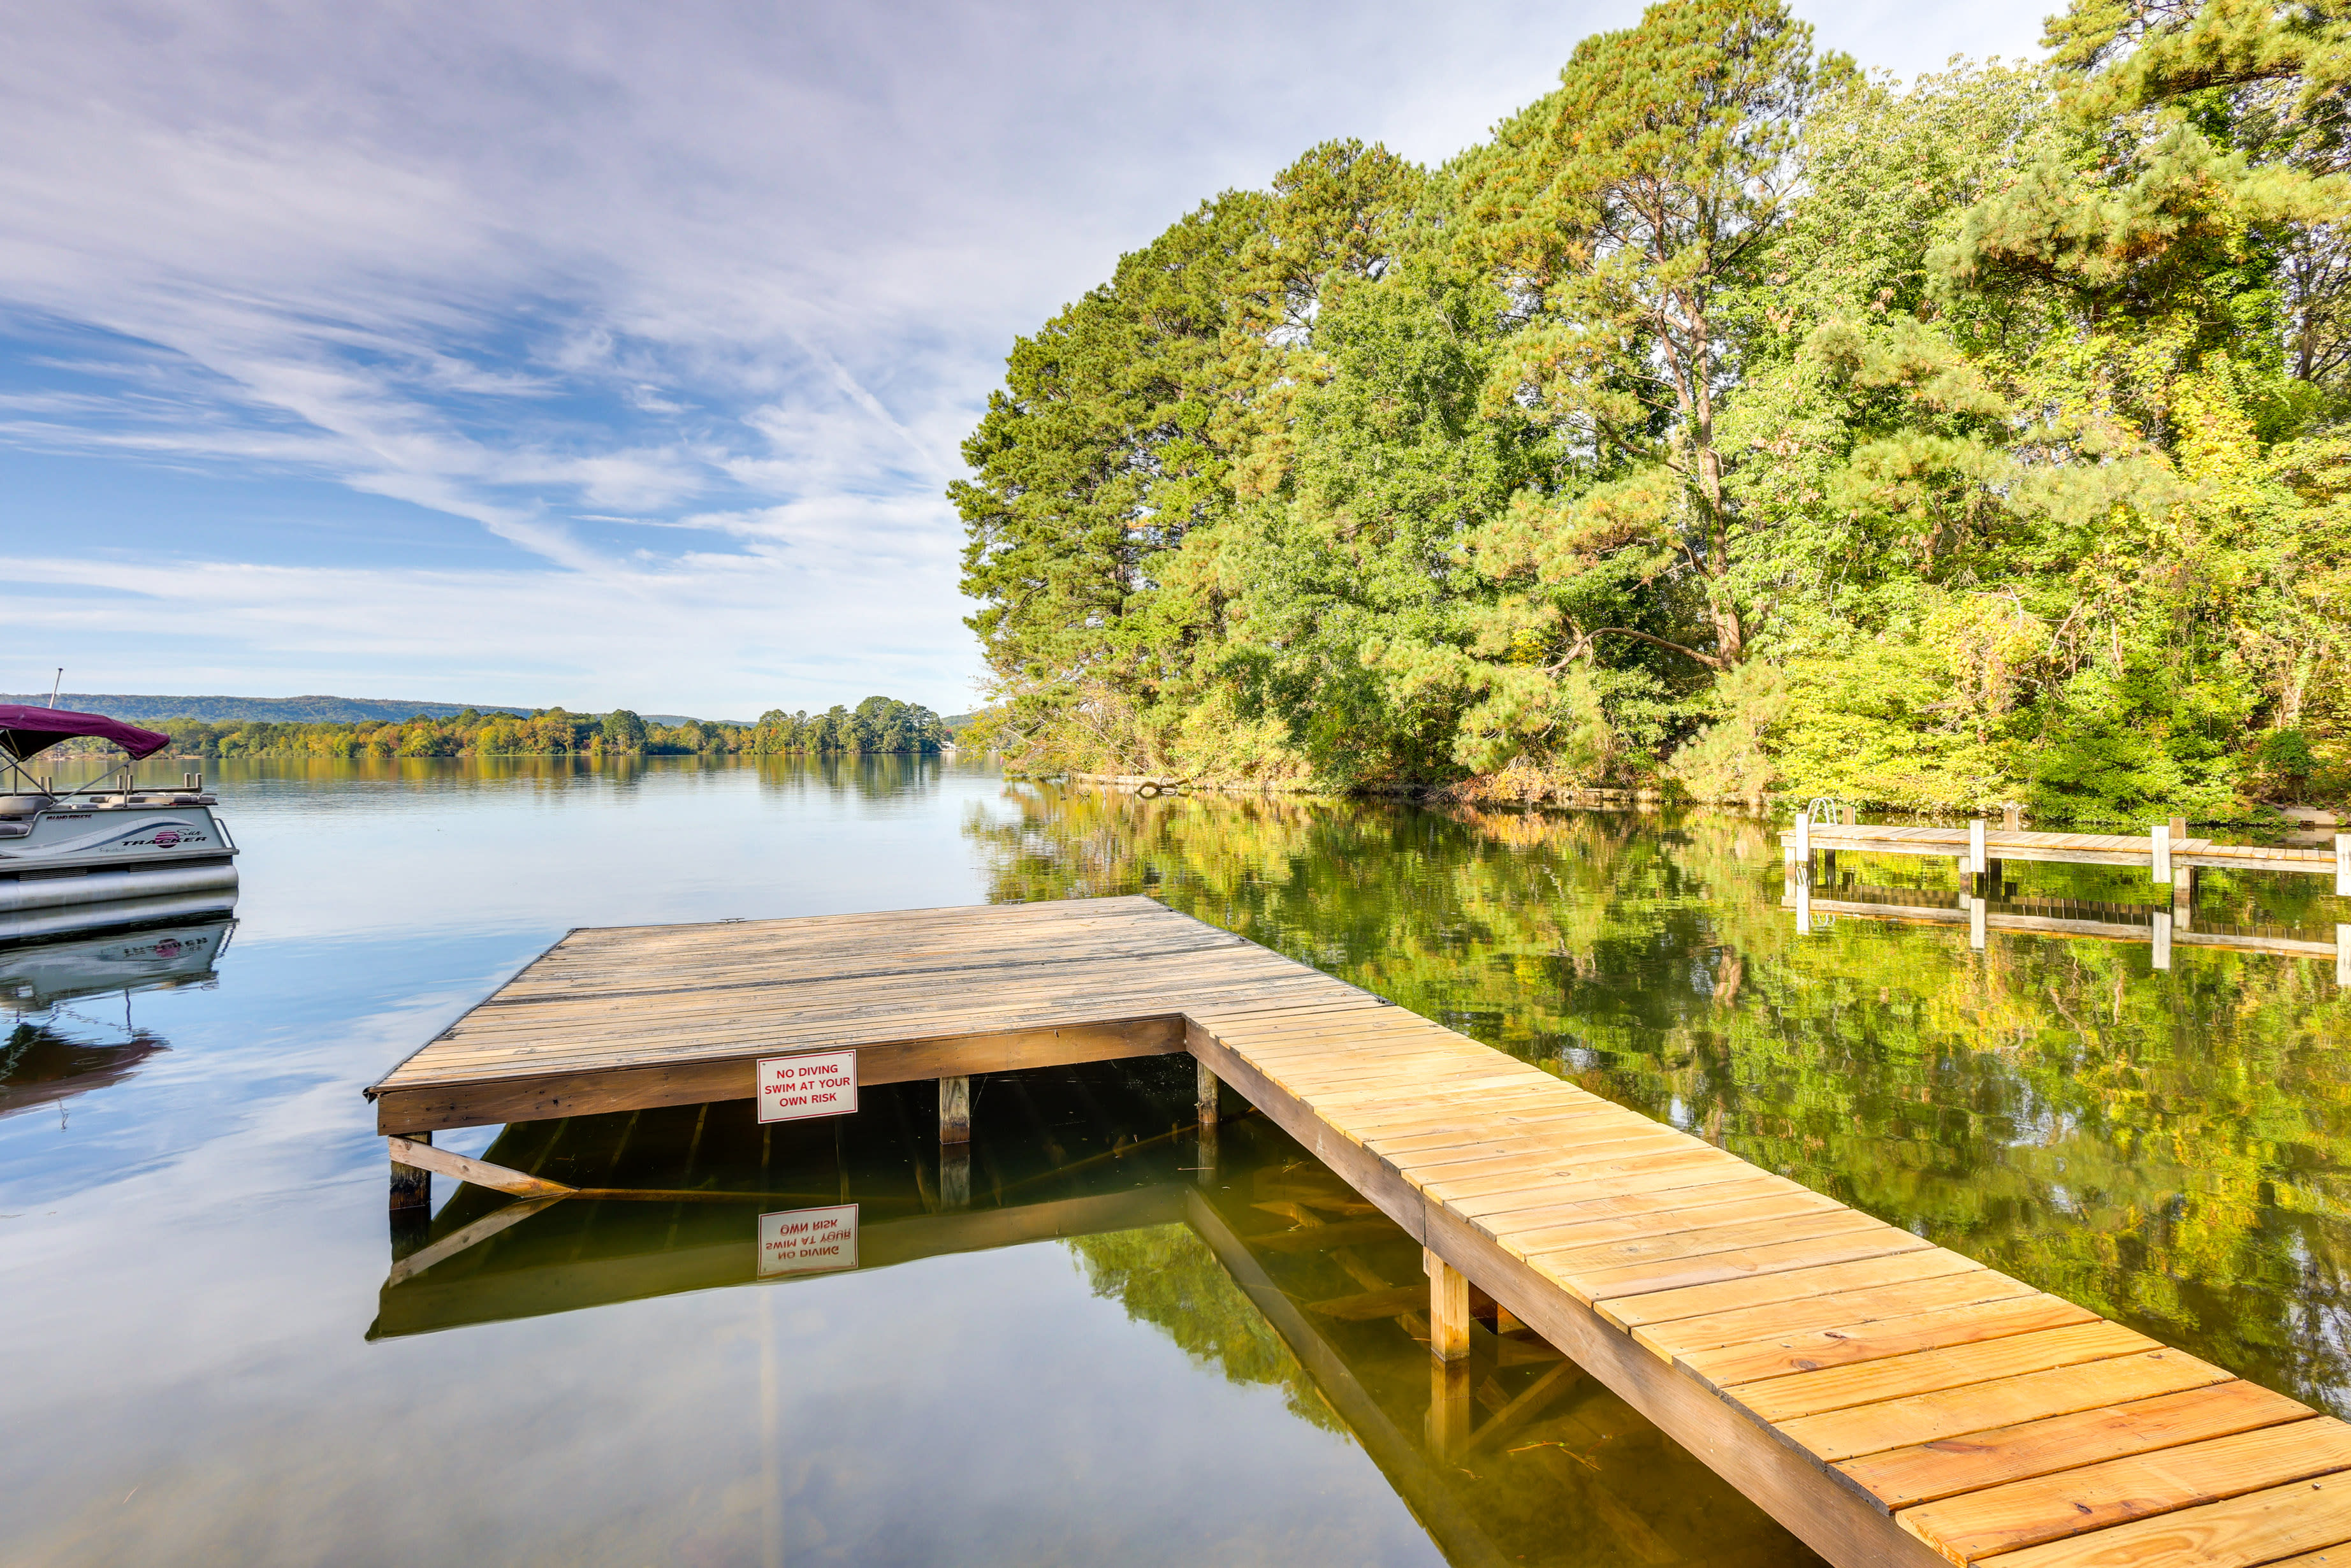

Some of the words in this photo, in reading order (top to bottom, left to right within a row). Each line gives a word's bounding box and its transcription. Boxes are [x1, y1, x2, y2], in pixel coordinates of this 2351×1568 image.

[175, 829, 203, 837] Sun
[122, 837, 207, 846] TRACKER
[776, 1069, 794, 1079] NO
[799, 1064, 838, 1077] DIVING
[764, 1083, 796, 1094] SWIM
[800, 1081, 815, 1091] AT
[819, 1077, 850, 1089] YOUR
[780, 1096, 807, 1107] OWN
[812, 1093, 837, 1103] RISK
